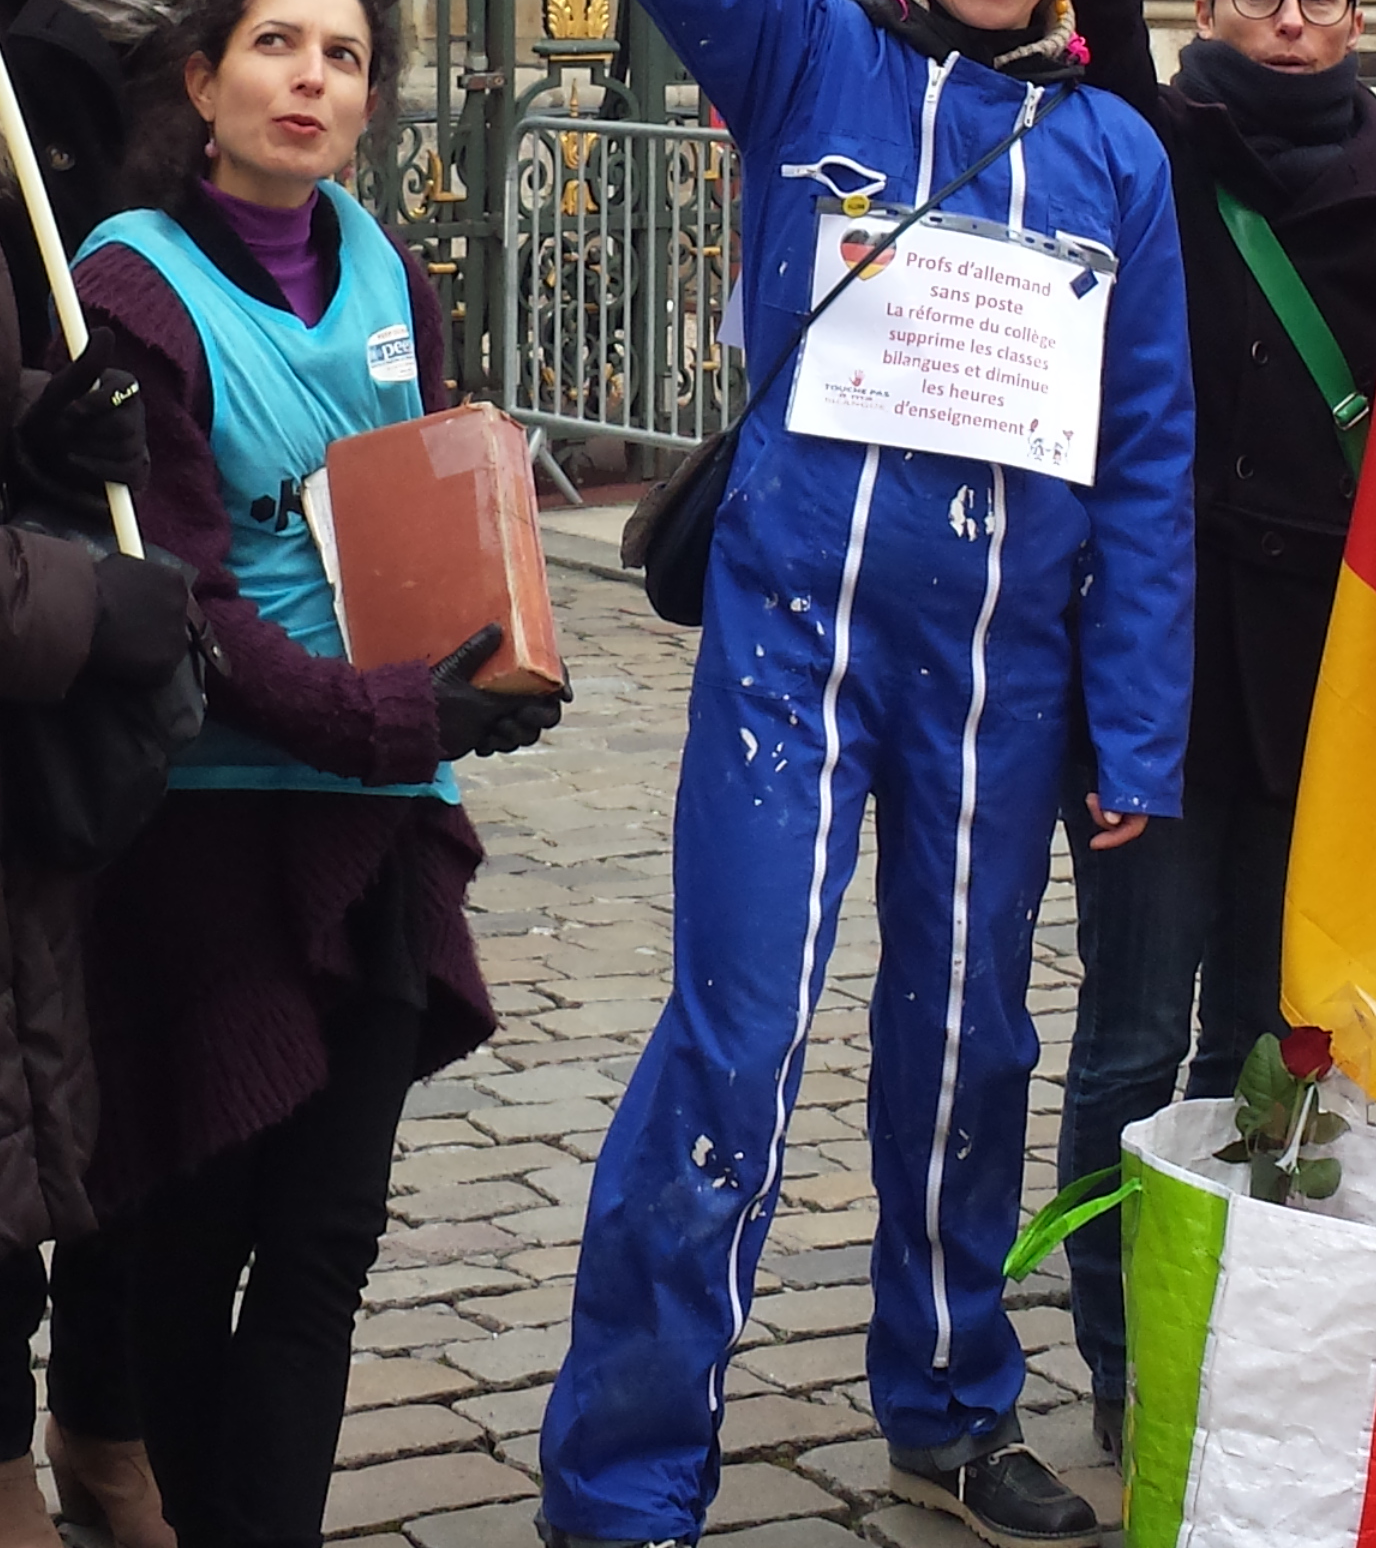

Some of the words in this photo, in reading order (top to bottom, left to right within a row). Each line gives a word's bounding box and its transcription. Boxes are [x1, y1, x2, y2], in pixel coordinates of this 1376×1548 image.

[906, 251, 953, 274] Profs
[957, 262, 1052, 297] d'allemand
[930, 284, 971, 304] sans
[975, 295, 1024, 316] poste
[886, 302, 904, 318] La
[908, 304, 975, 329] réforme
[979, 316, 1000, 334] du
[1004, 322, 1057, 350] collège
[888, 329, 966, 352] supprime
[970, 339, 992, 356] les
[996, 346, 1050, 371] classes
[883, 350, 960, 378] bilangues
[964, 360, 981, 378] et
[985, 367, 1050, 395] diminue
[921, 379, 944, 396] les
[948, 384, 1006, 408] heures
[893, 401, 1025, 437] d'enseignement
